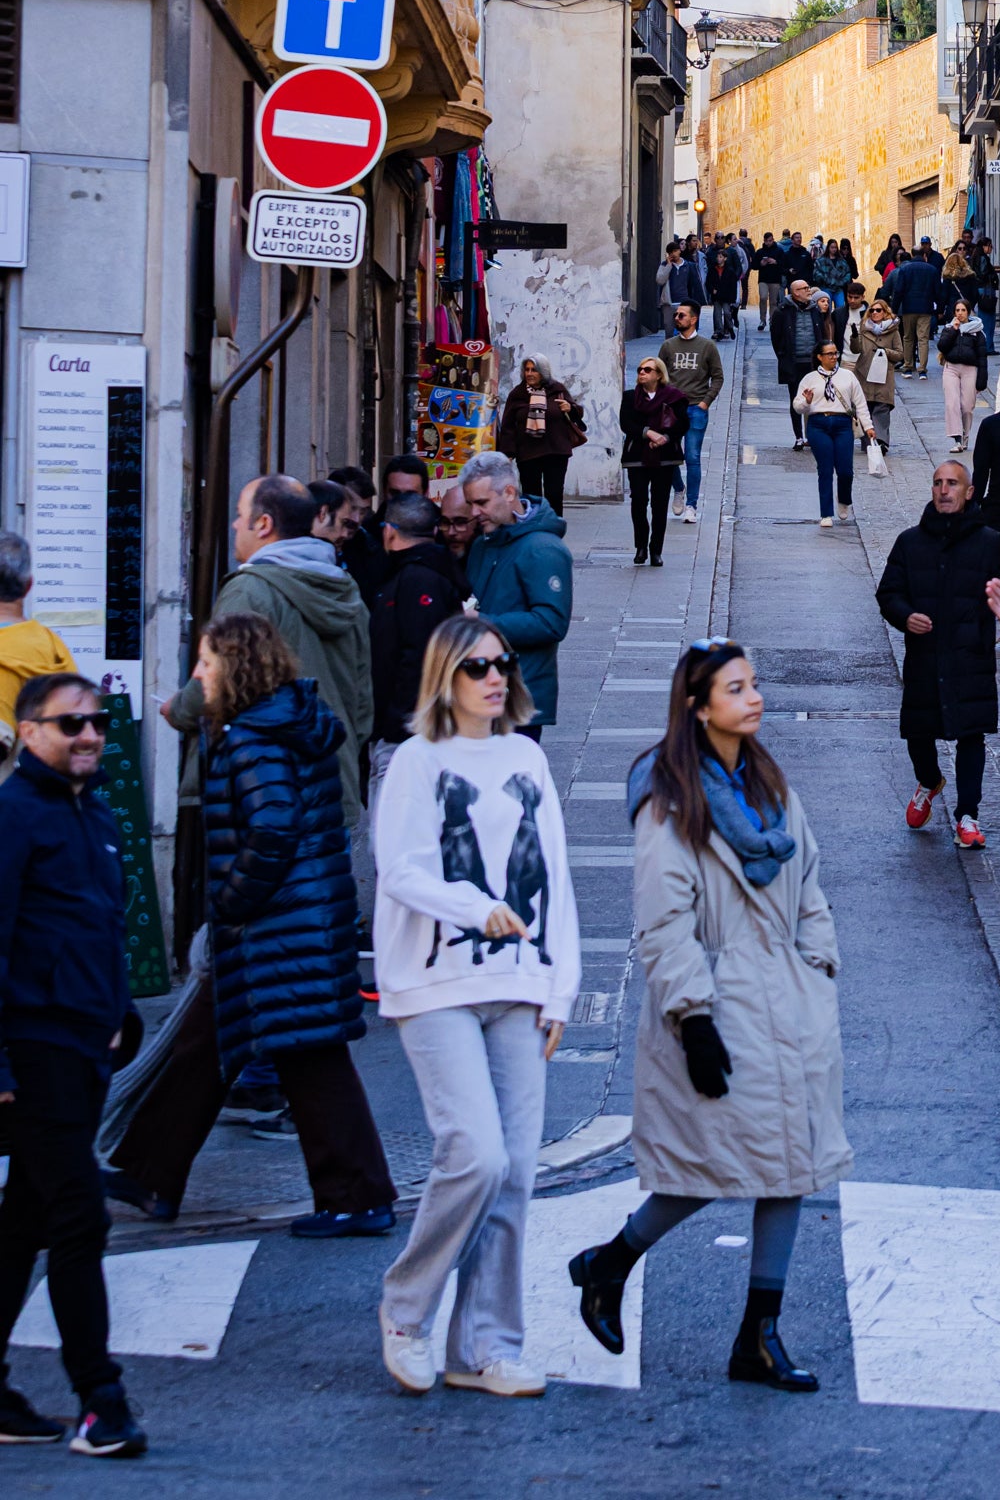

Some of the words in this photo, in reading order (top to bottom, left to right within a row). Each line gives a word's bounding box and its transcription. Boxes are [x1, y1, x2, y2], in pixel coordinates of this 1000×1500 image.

[276, 215, 340, 230] EXCEPTO
[262, 228, 352, 244] VEHICULOS
[260, 241, 352, 257] AUTORIZADOS
[49, 353, 91, 373] Carta
